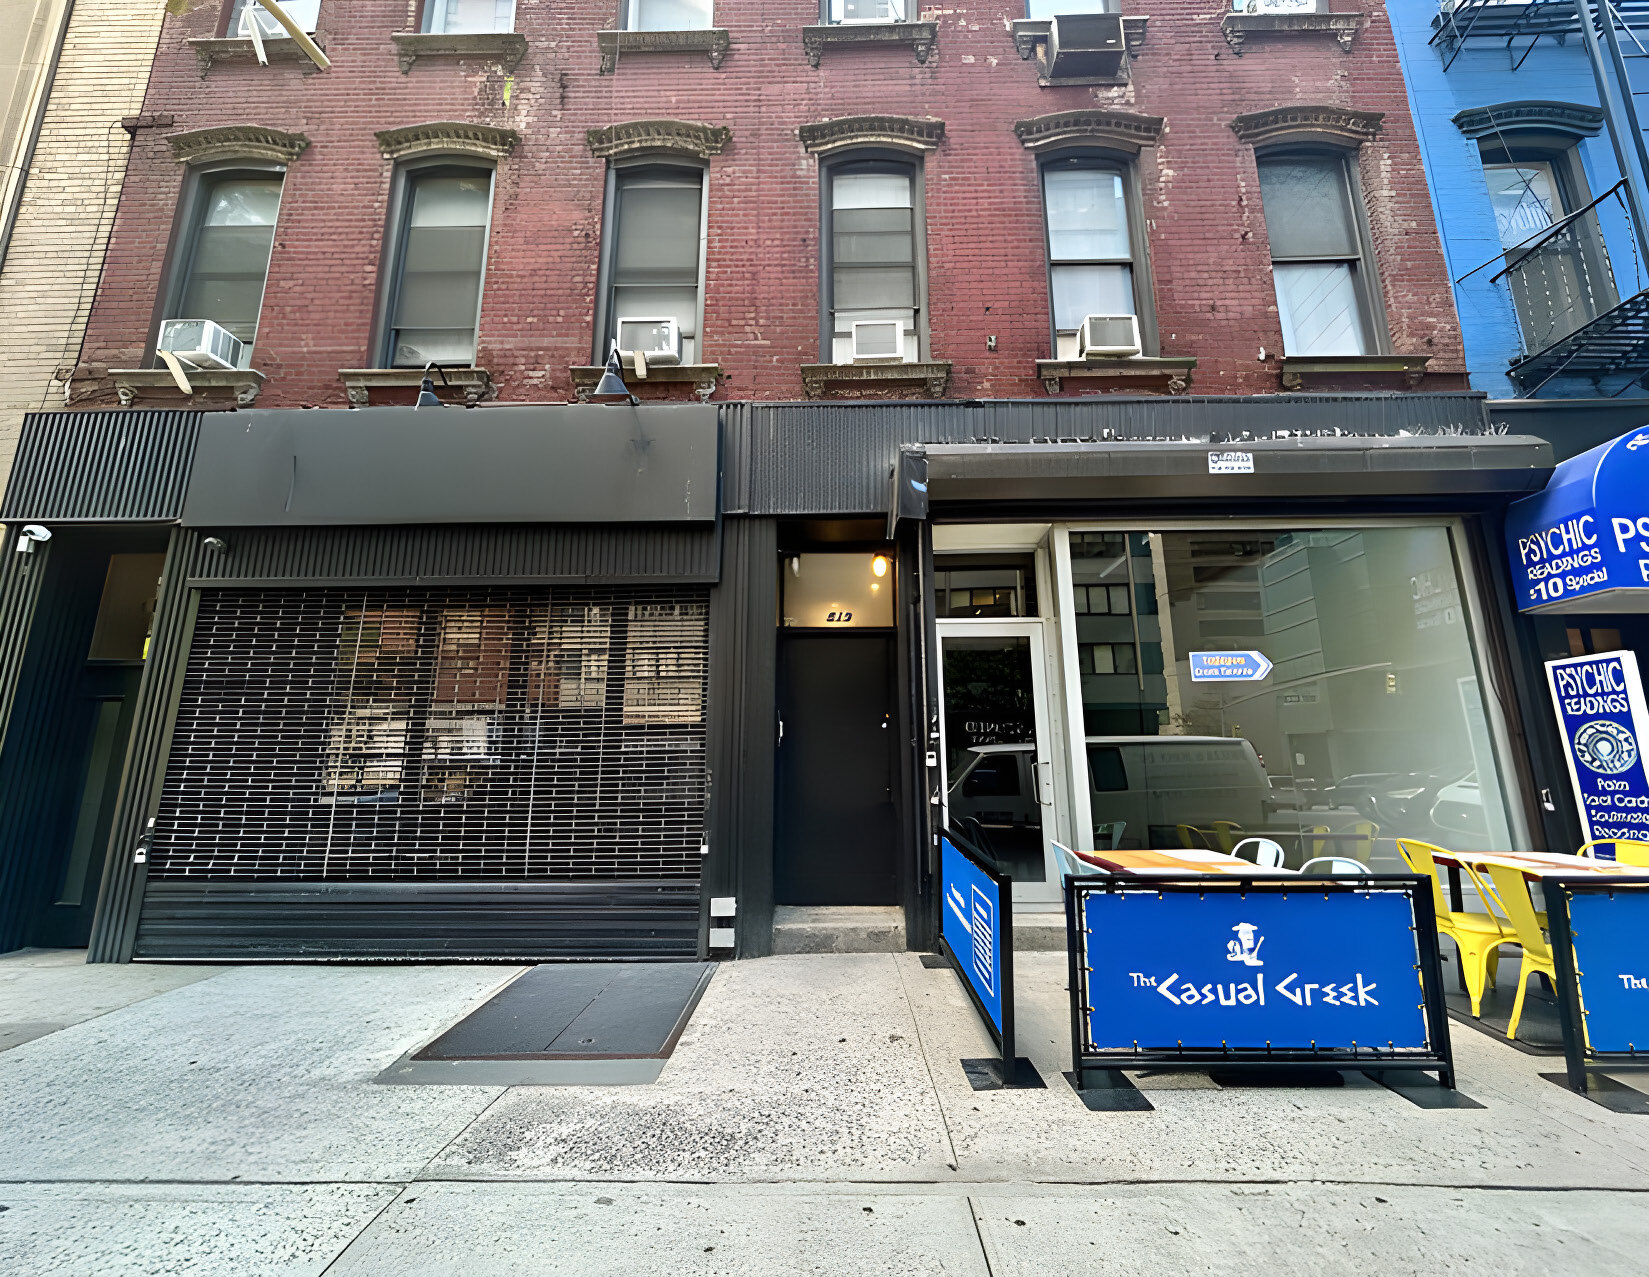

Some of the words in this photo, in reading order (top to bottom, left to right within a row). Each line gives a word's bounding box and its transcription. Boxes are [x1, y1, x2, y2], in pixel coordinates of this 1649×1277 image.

[1518, 514, 1598, 566] PSYCHIC
[1556, 661, 1625, 697] PSYCHIC
[1128, 972, 1157, 987] The
[1156, 972, 1266, 1006] Casual
[1275, 972, 1380, 1007] Greek
